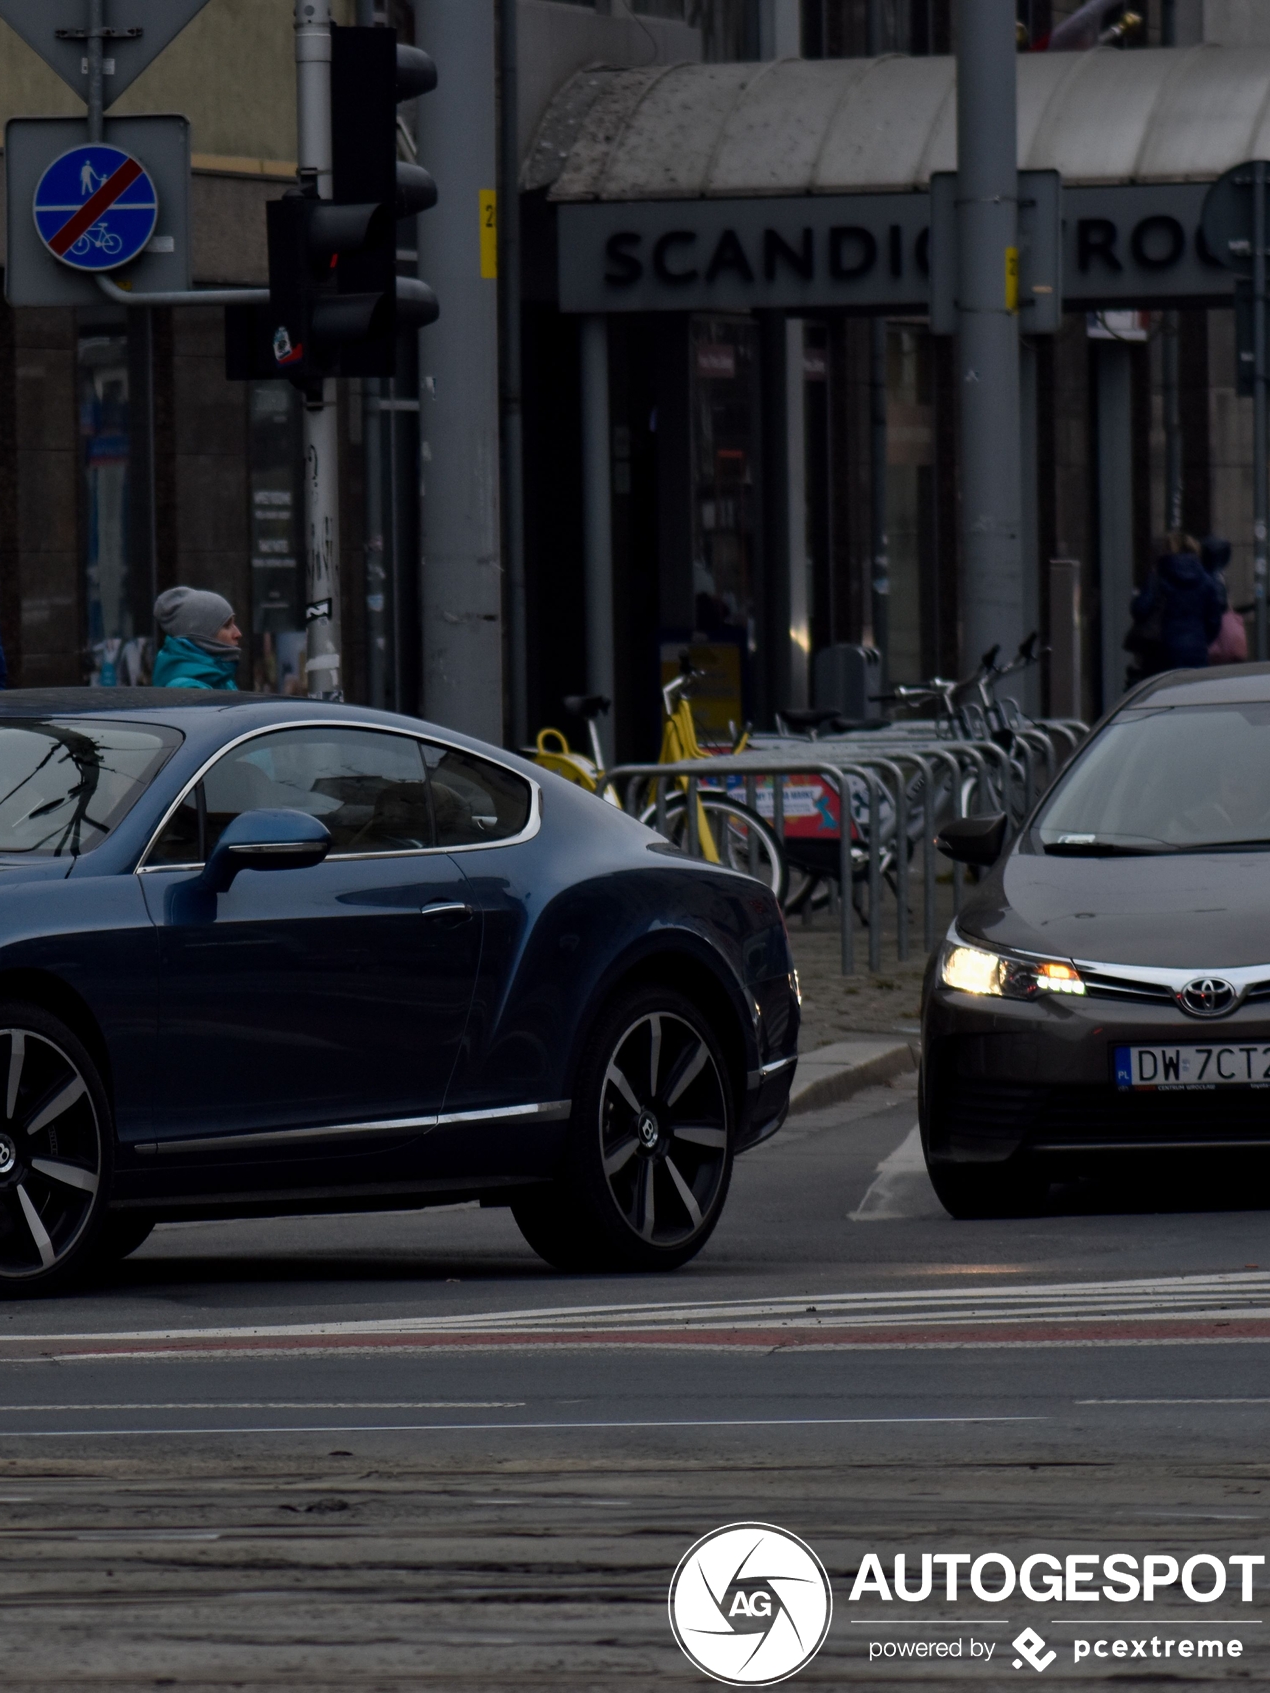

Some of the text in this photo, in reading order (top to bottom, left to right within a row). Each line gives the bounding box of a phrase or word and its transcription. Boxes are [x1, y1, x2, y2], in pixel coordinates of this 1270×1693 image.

[485, 205, 493, 227] 2
[605, 224, 929, 285] SCANDI
[1118, 1070, 1129, 1080] PL
[1138, 1049, 1180, 1081] DW
